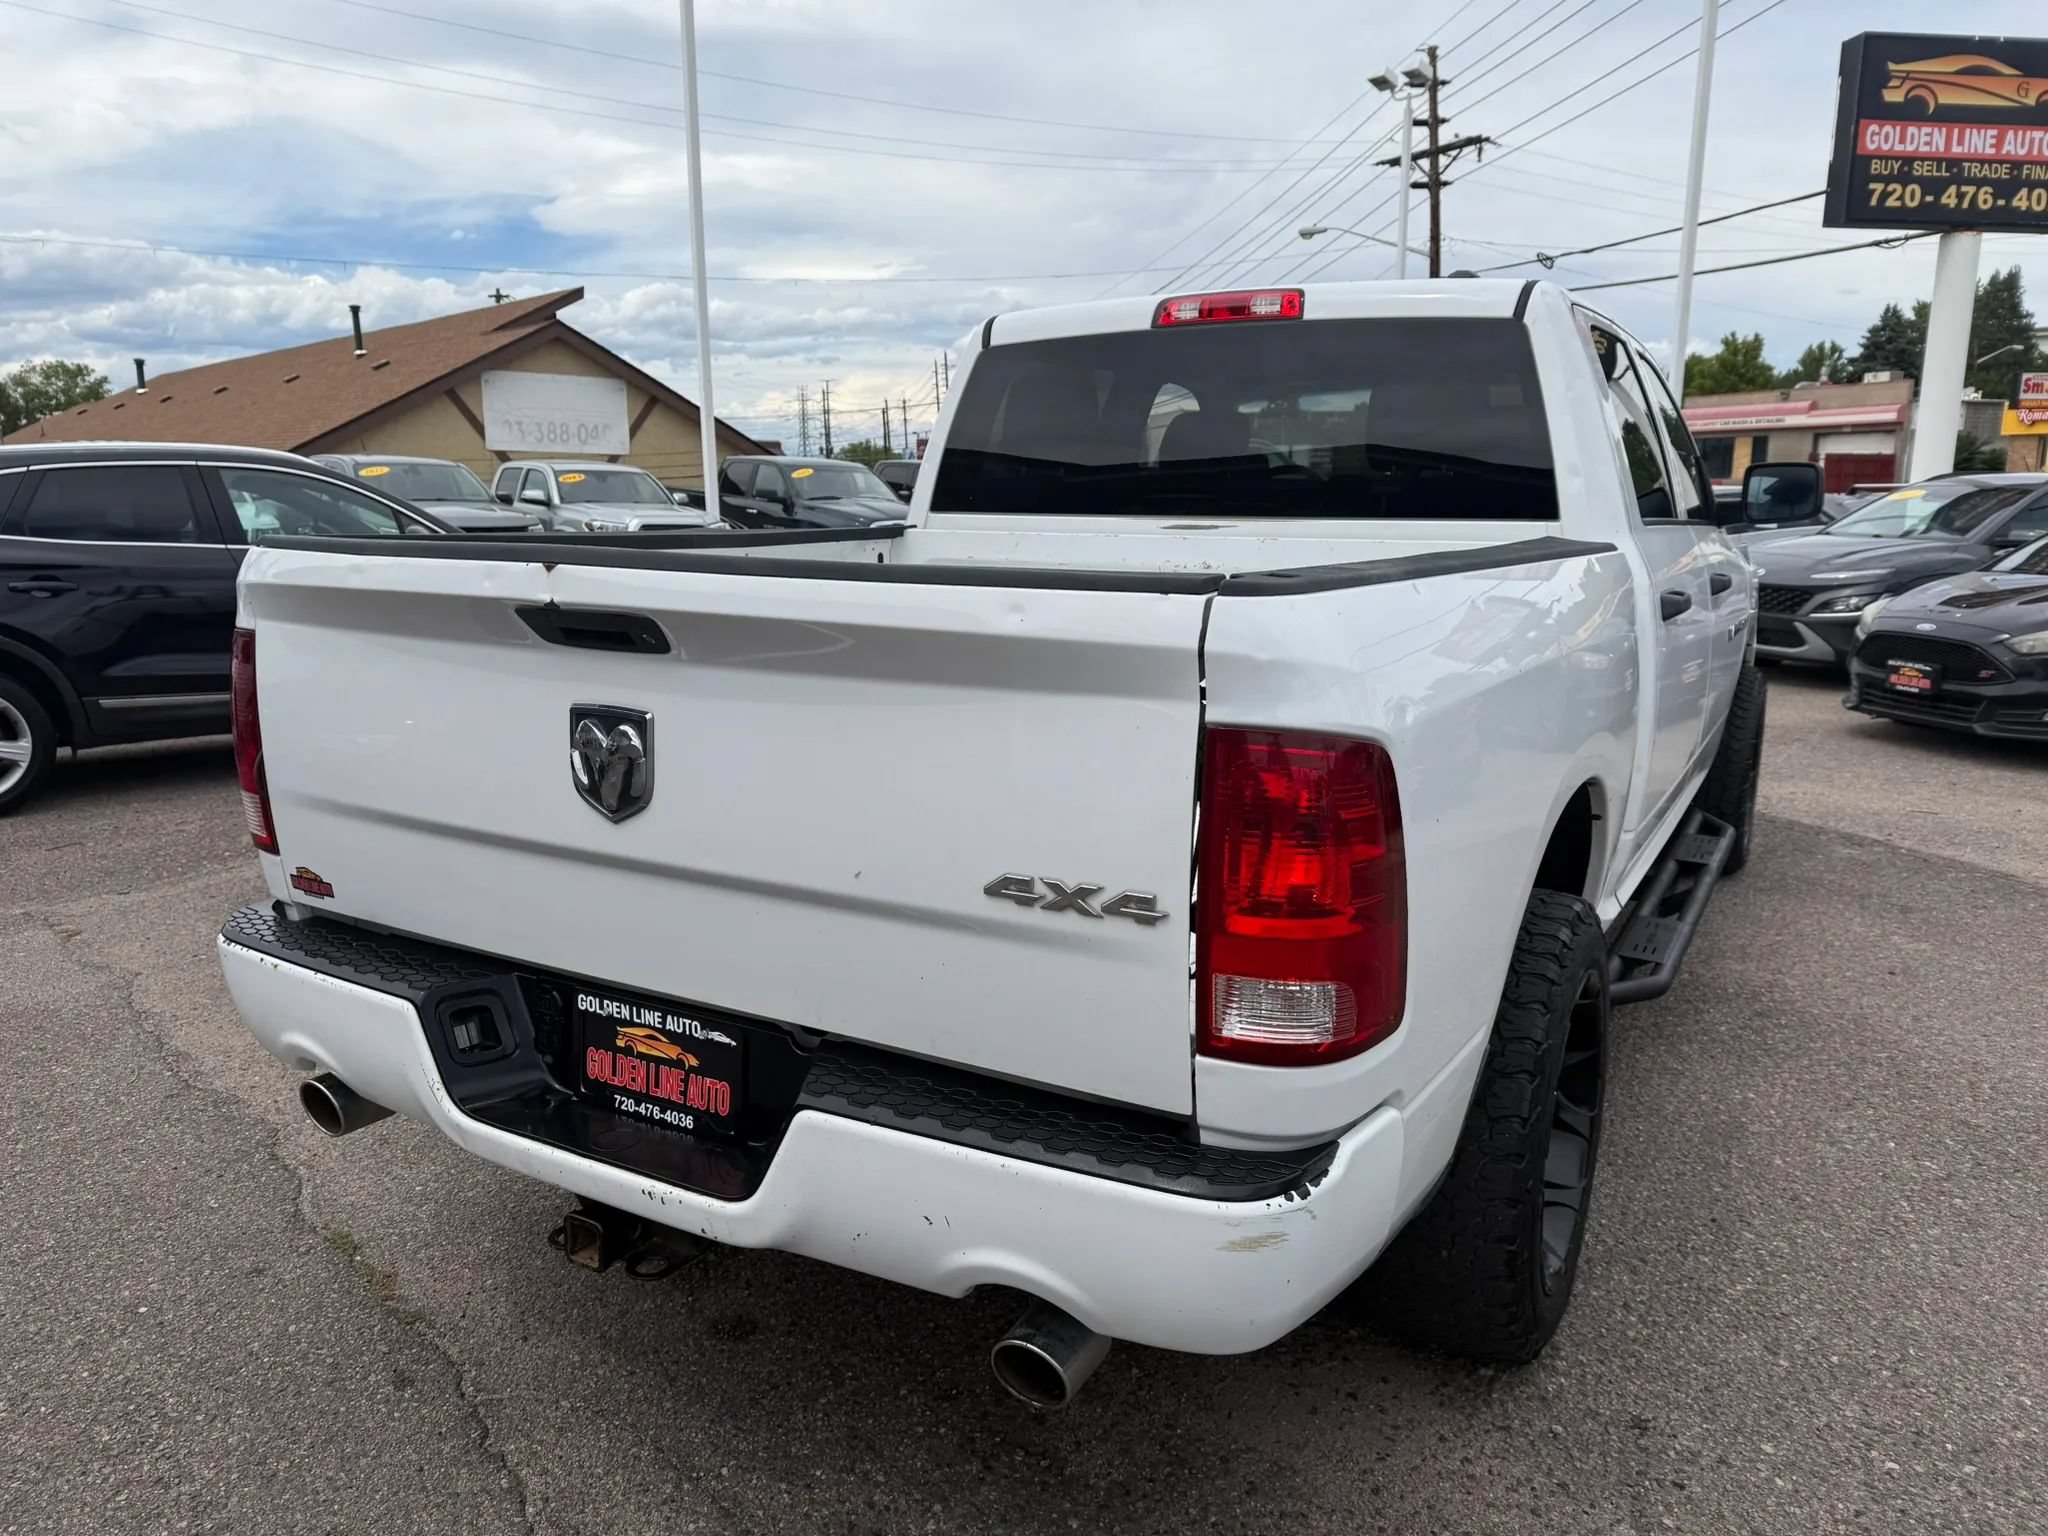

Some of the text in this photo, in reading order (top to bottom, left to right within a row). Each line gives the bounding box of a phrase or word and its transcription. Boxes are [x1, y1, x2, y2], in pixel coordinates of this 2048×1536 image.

[2016, 81, 2031, 99] G
[1865, 123, 1947, 153] GOLDEN
[1951, 127, 1998, 155] LINE
[1870, 159, 1902, 176] BUY
[1912, 160, 1951, 177] SELL
[1962, 162, 2011, 179] TRADE
[983, 872, 1170, 927] 4X4
[577, 993, 702, 1038] GOLDEN LINE AUTO
[586, 1046, 731, 1117] GOLDEN LINE AUTO
[614, 1094, 694, 1129] 720-476-4036
